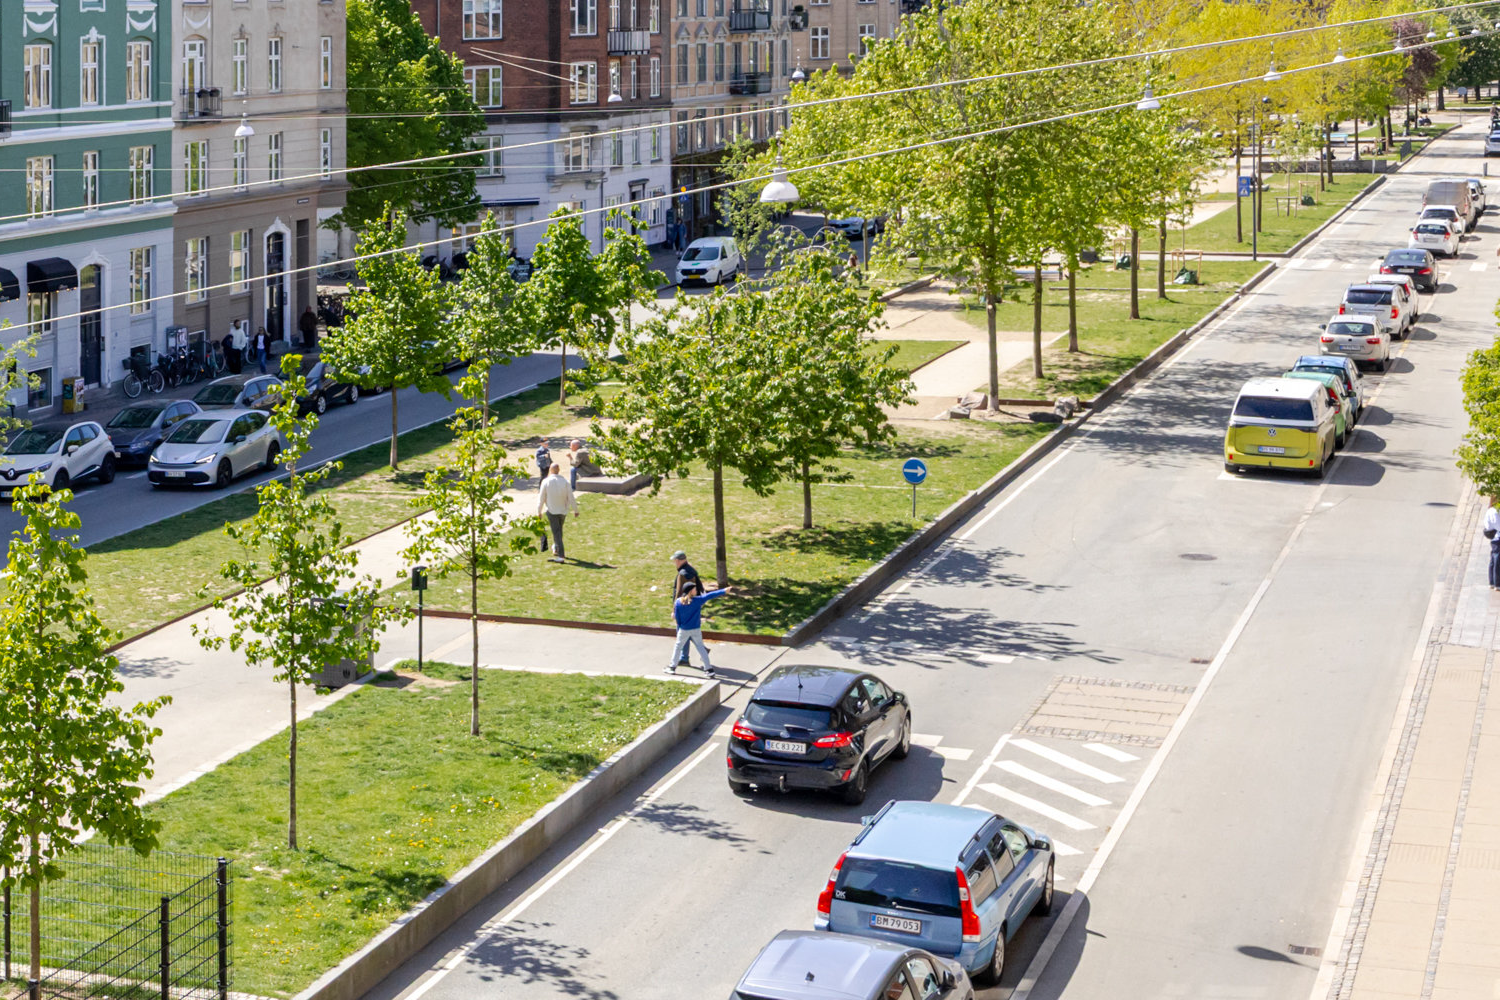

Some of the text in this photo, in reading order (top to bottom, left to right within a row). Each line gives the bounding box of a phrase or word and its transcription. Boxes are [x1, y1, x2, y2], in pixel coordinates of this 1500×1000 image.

[835, 890, 846, 899] DK
[876, 916, 919, 931] BM 79 053
